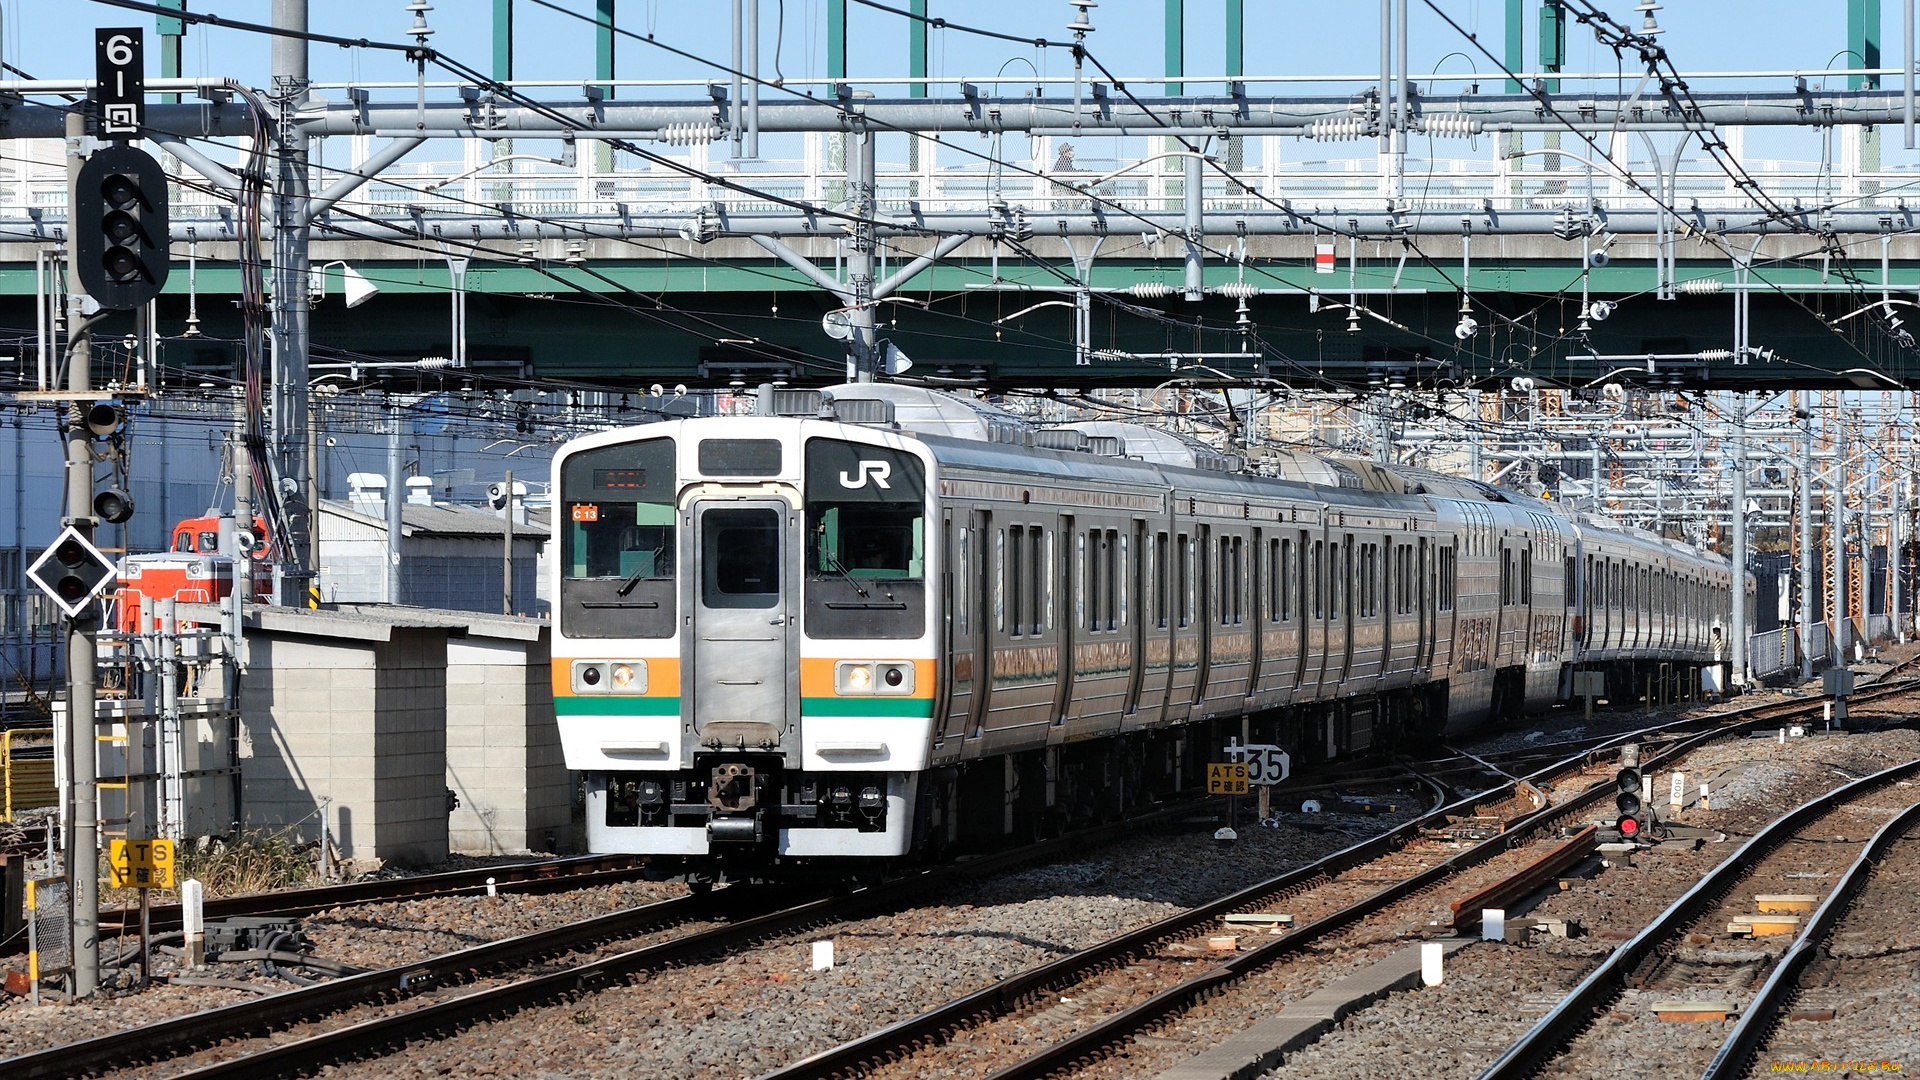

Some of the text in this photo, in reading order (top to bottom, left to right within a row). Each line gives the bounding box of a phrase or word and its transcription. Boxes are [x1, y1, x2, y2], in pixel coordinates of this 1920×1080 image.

[840, 460, 891, 489] JR
[573, 510, 597, 519] C 13
[1211, 766, 1245, 777] ATS
[1673, 778, 1683, 799] 800
[118, 844, 168, 862] ATS
